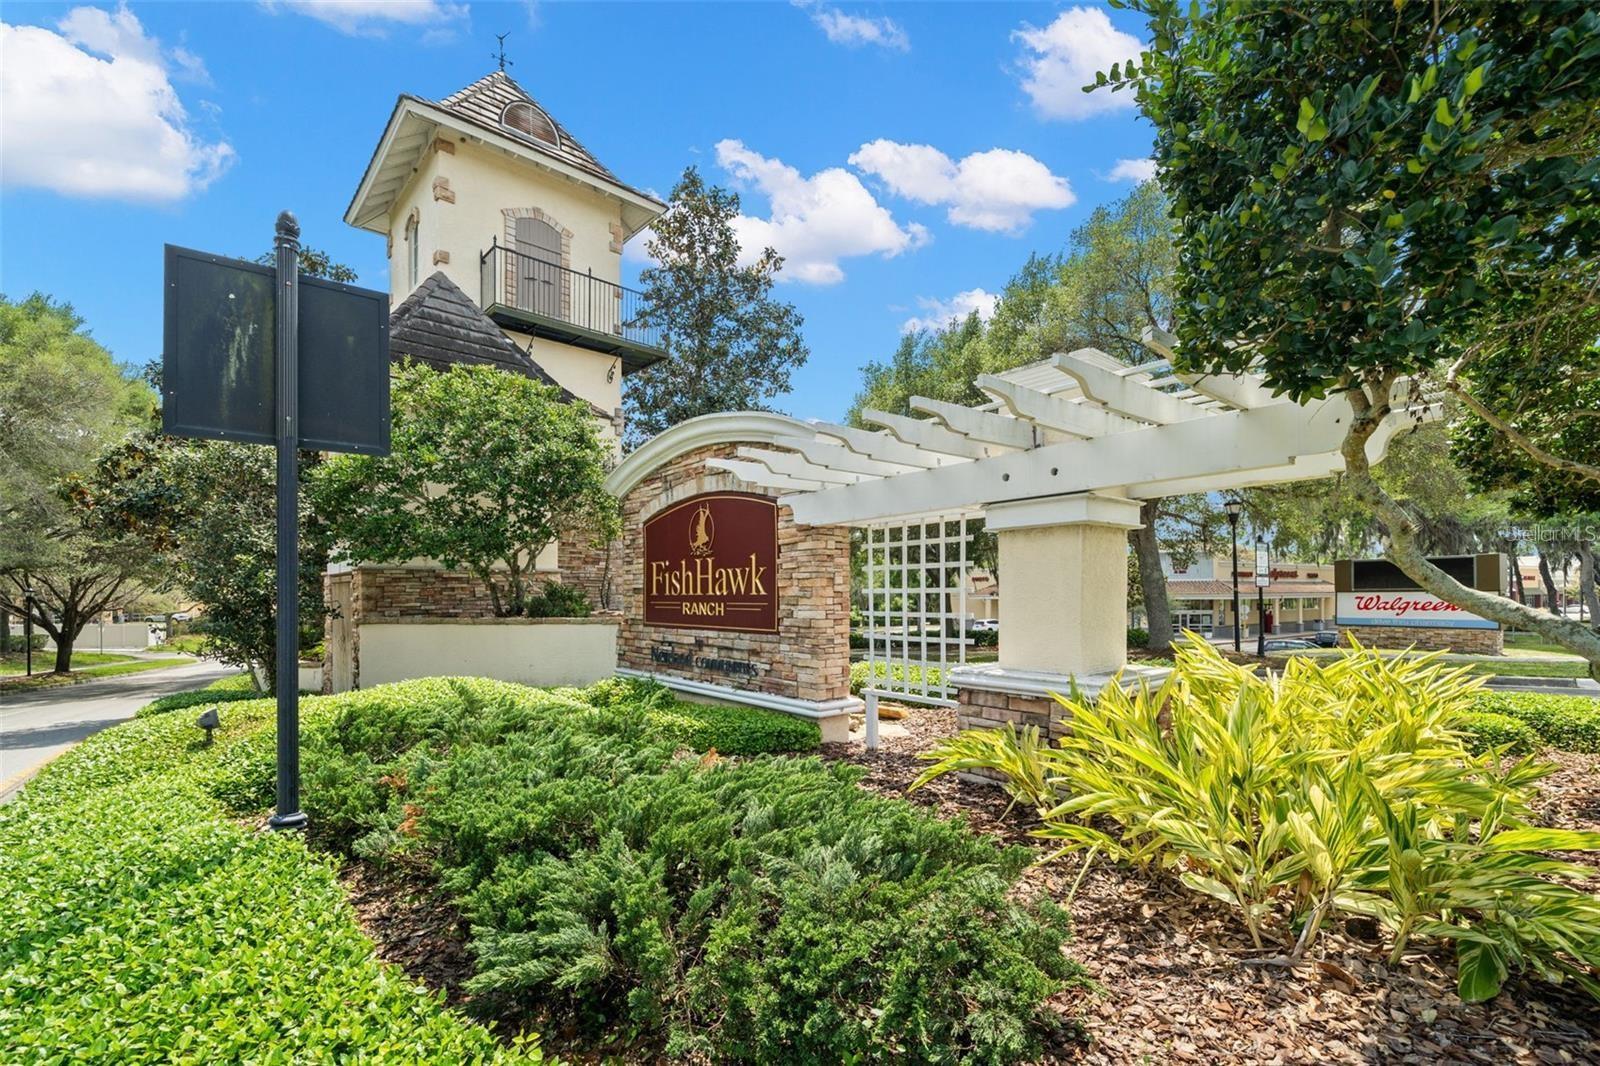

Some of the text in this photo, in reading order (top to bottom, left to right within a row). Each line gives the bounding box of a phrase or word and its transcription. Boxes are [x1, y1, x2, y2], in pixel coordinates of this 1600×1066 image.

[651, 553, 768, 597] FishHawk
[682, 602, 724, 616] RANCH
[1354, 594, 1465, 616] Walgreen
